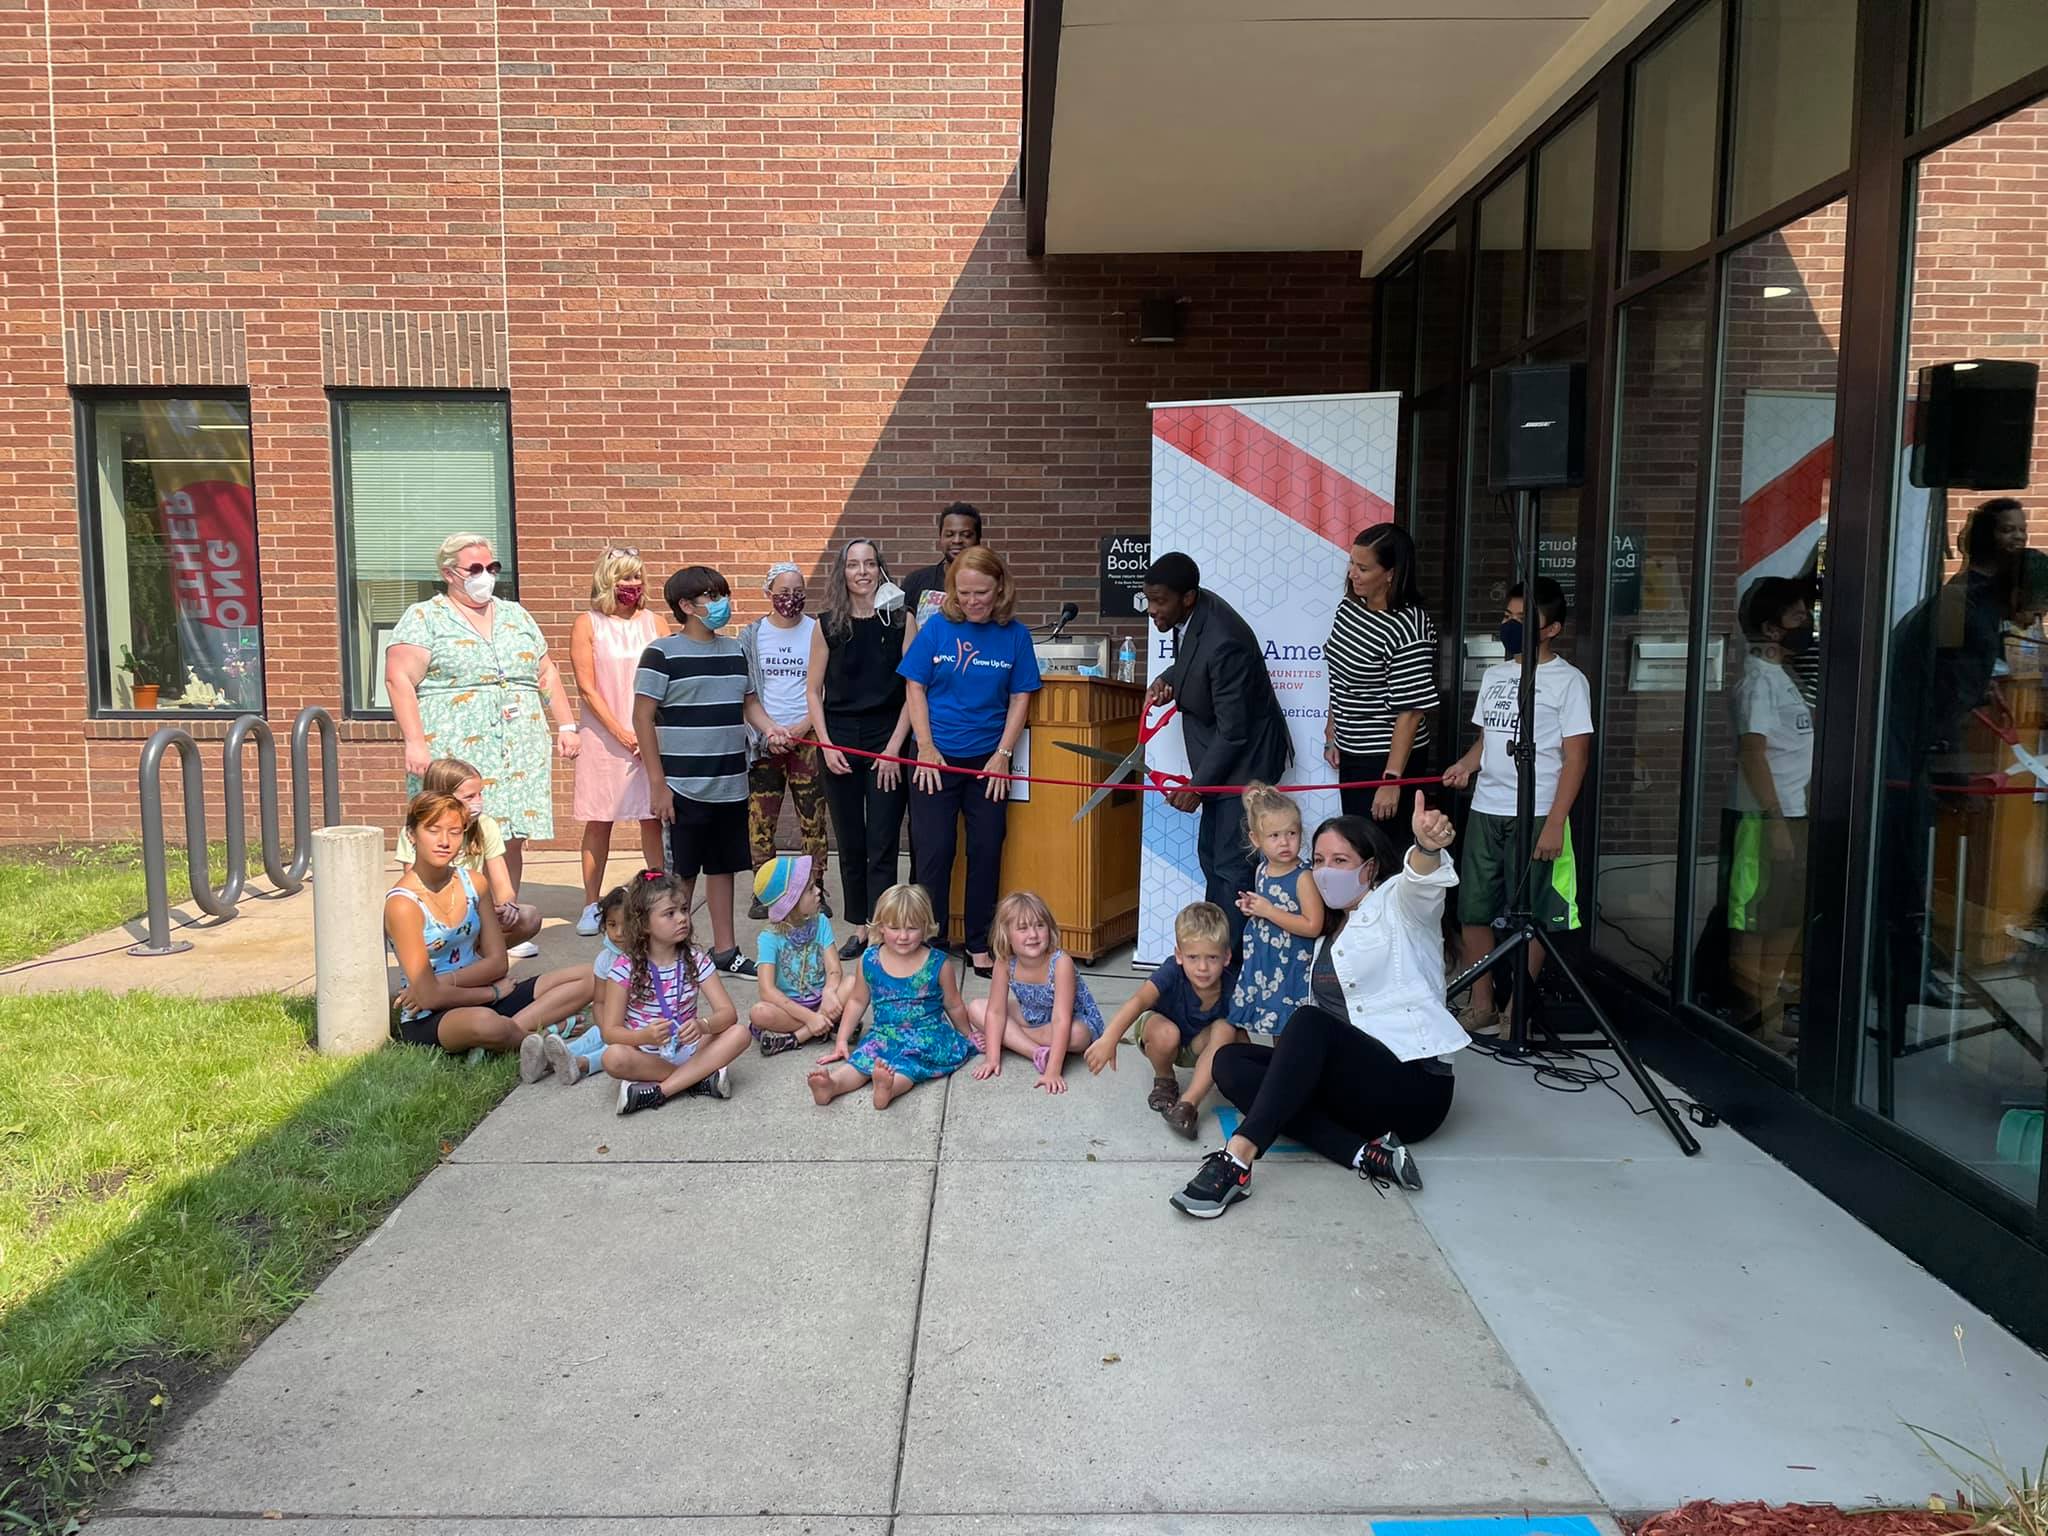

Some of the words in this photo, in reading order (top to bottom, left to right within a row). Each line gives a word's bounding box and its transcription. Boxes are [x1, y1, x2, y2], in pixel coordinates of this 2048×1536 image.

[1110, 538, 1151, 553] After
[1107, 555, 1148, 570] Book
[1264, 640, 1328, 660] Ame
[765, 657, 804, 665] BELONG
[972, 658, 990, 666] Grow
[990, 660, 1000, 668] Up
[761, 669, 808, 678] TOGETHER
[1268, 670, 1322, 678] MUNITIES
[1483, 685, 1520, 702] TALE
[1494, 700, 1512, 710] HAS
